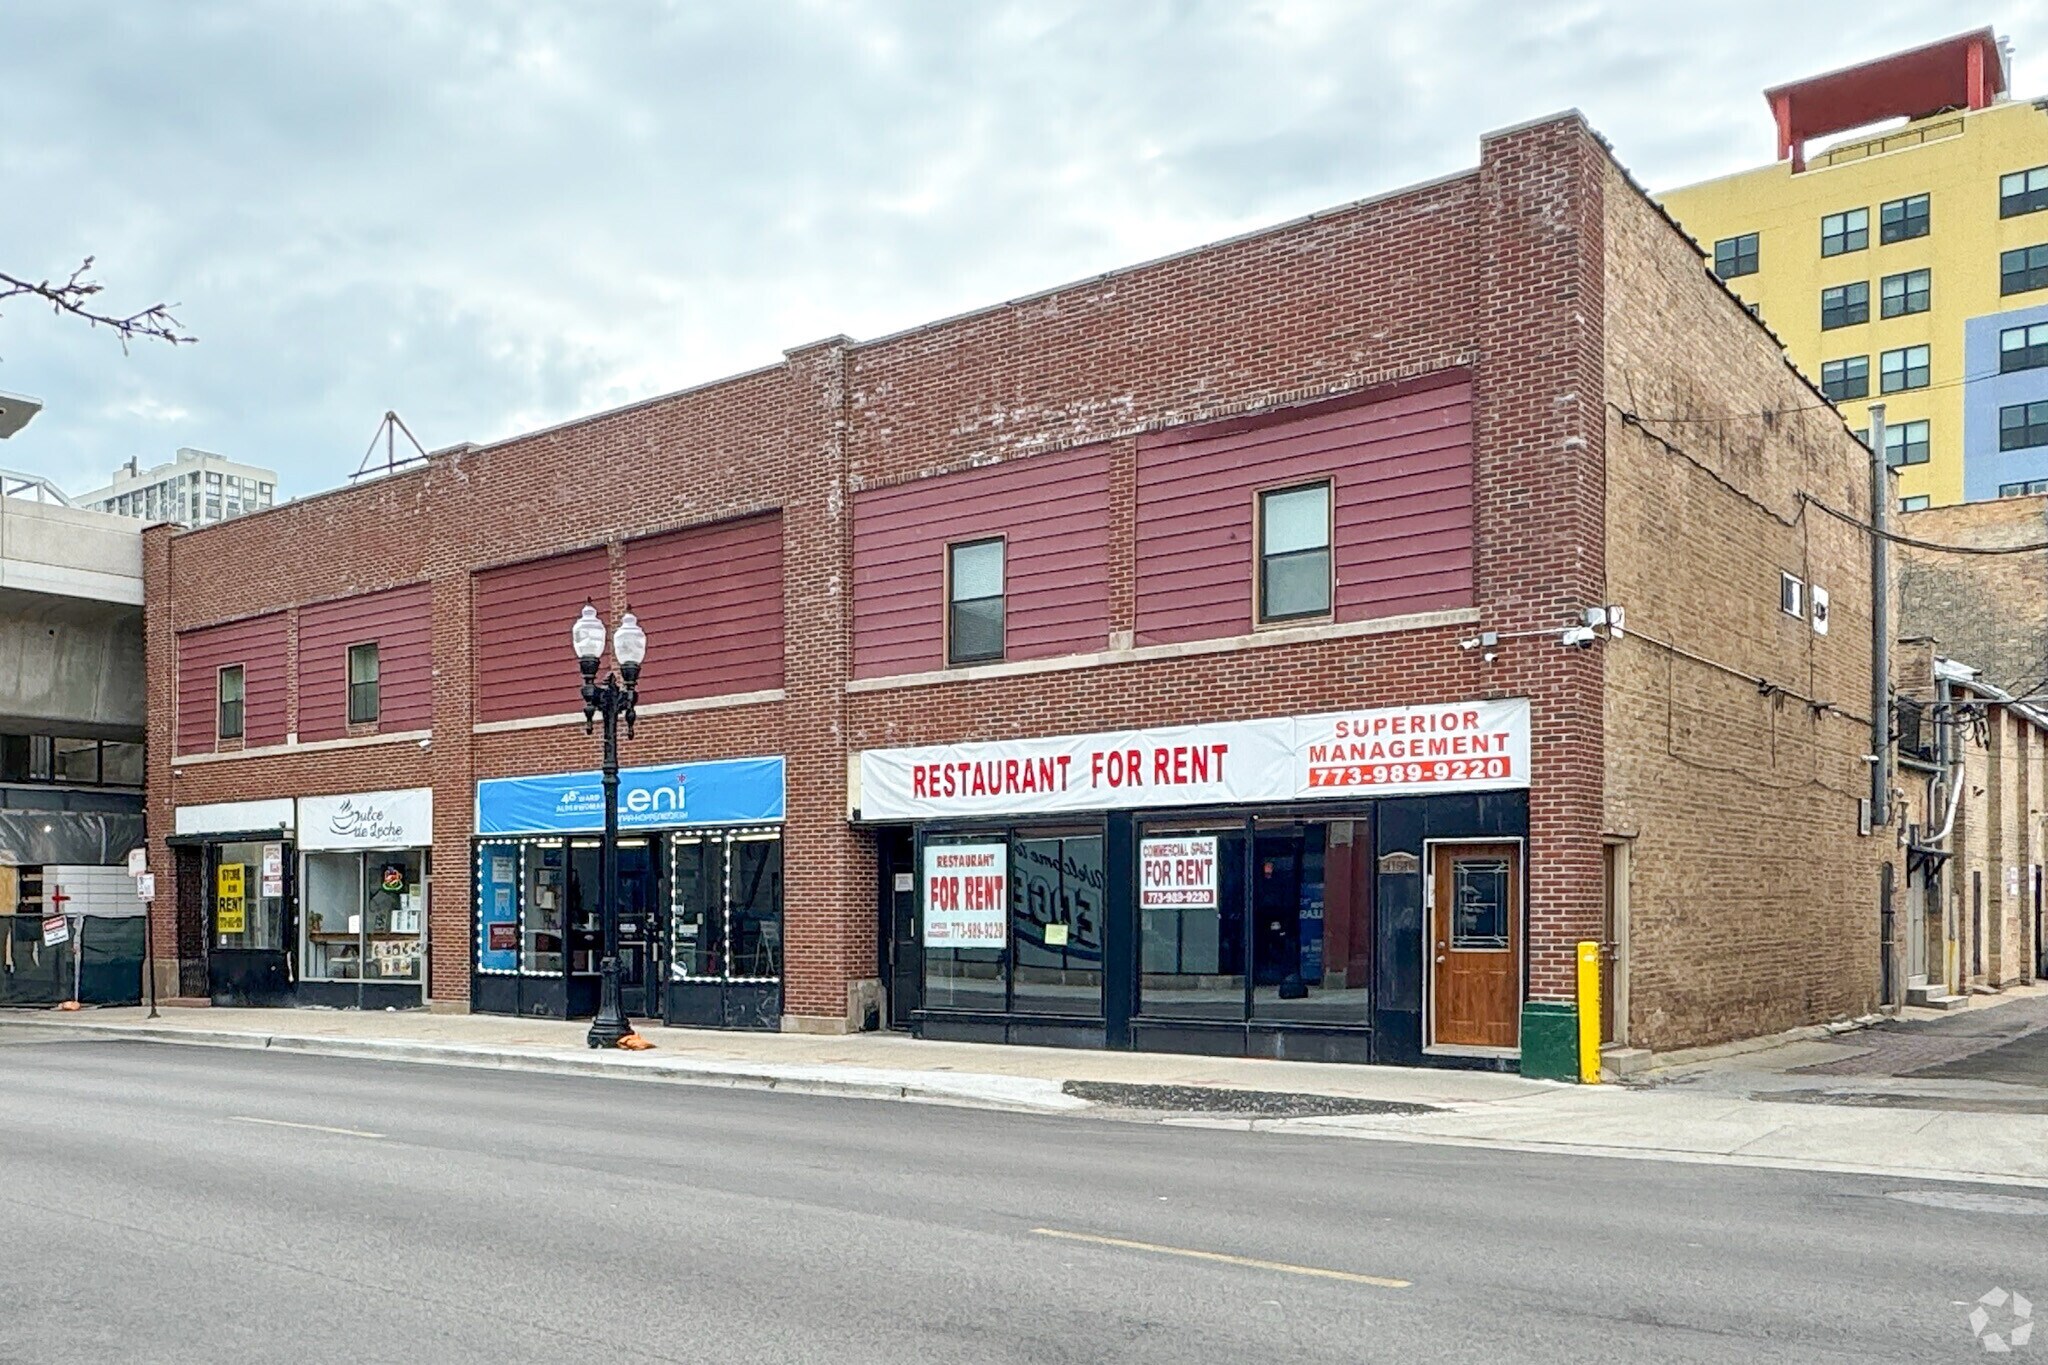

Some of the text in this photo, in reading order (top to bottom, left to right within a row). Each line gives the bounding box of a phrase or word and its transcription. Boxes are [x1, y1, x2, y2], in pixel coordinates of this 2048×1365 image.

[1335, 711, 1480, 738] SUPERIOR
[1309, 733, 1510, 763] MANAGEMENT
[913, 744, 1229, 798] RESTAURANT FOR RENT
[1315, 759, 1504, 785] 773-989-9220
[618, 777, 686, 813] eni
[936, 854, 995, 868] RESTAURANT
[1145, 858, 1213, 887] FOR RENT
[219, 896, 243, 912] RENT
[930, 874, 1003, 912] FOR RENT
